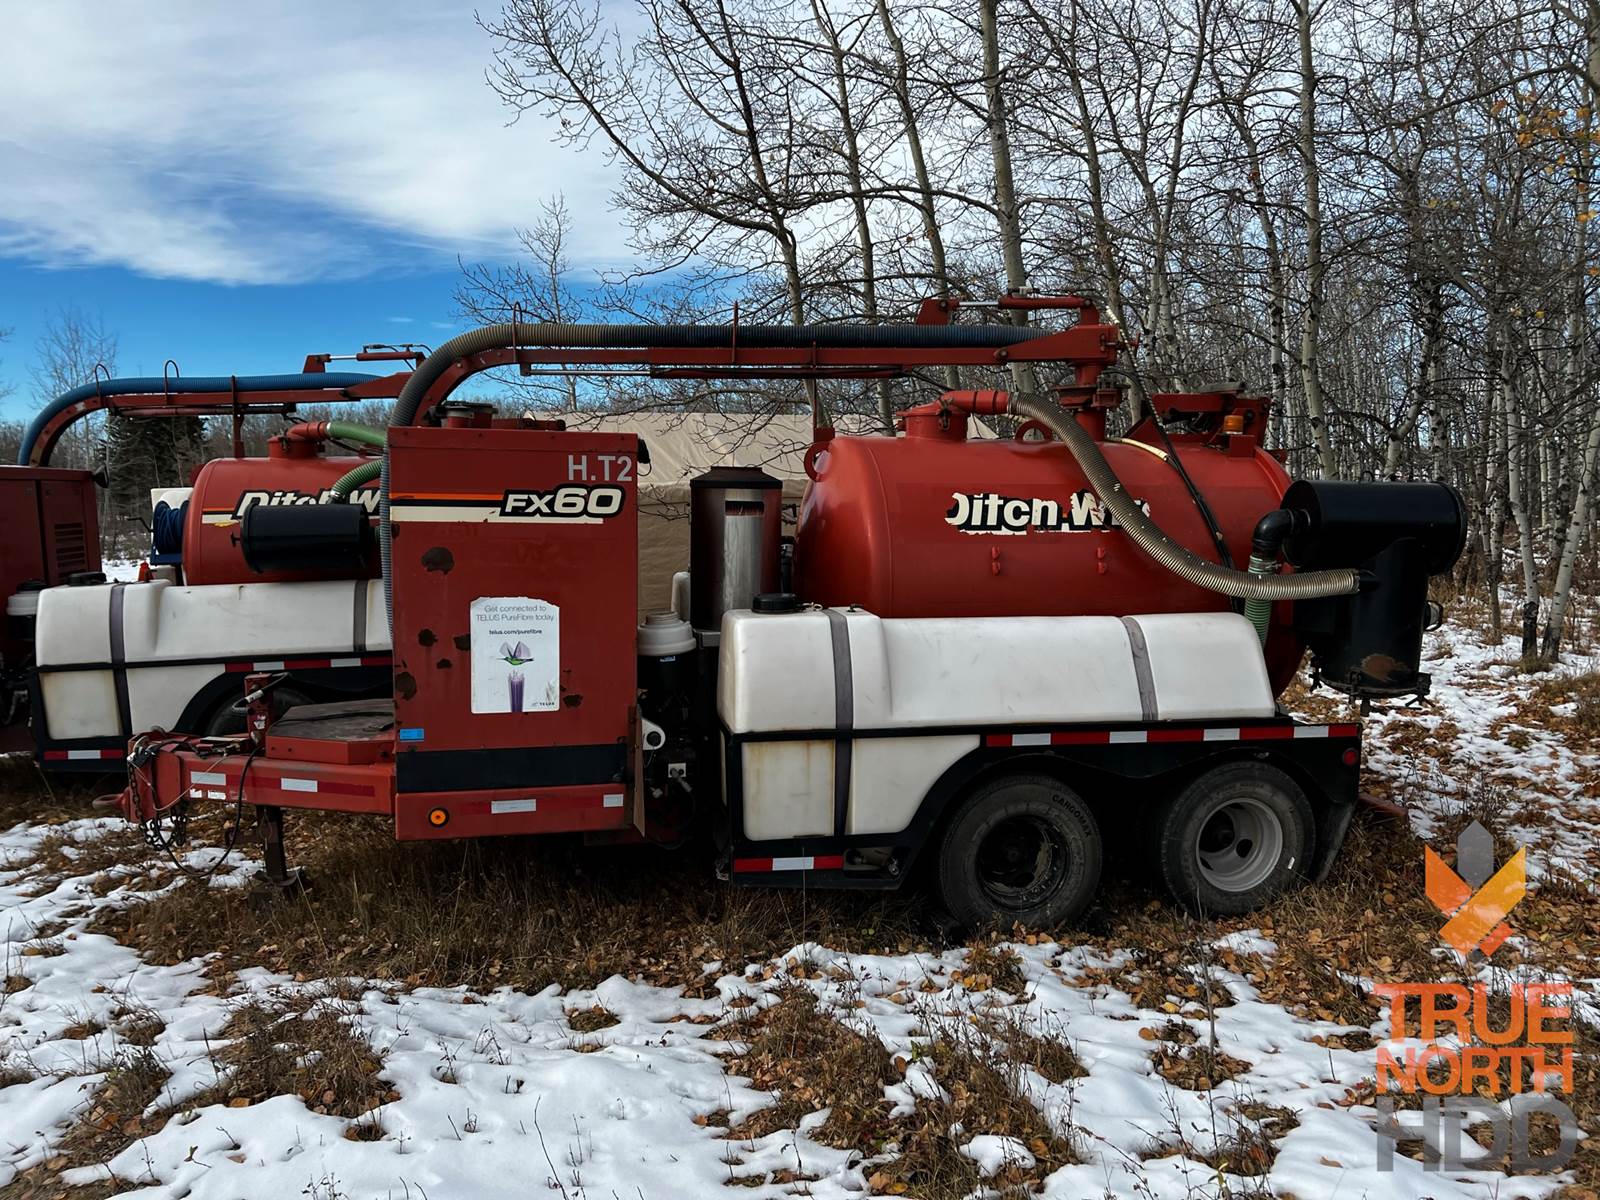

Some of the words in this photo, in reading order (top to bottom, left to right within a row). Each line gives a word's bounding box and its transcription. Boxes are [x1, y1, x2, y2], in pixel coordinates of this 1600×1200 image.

[568, 454, 632, 481] H.T2
[503, 486, 623, 515] FX60
[477, 614, 500, 622] TELUS
[501, 613, 534, 621] PureFibre
[484, 605, 498, 613] Get
[500, 605, 538, 613] connected
